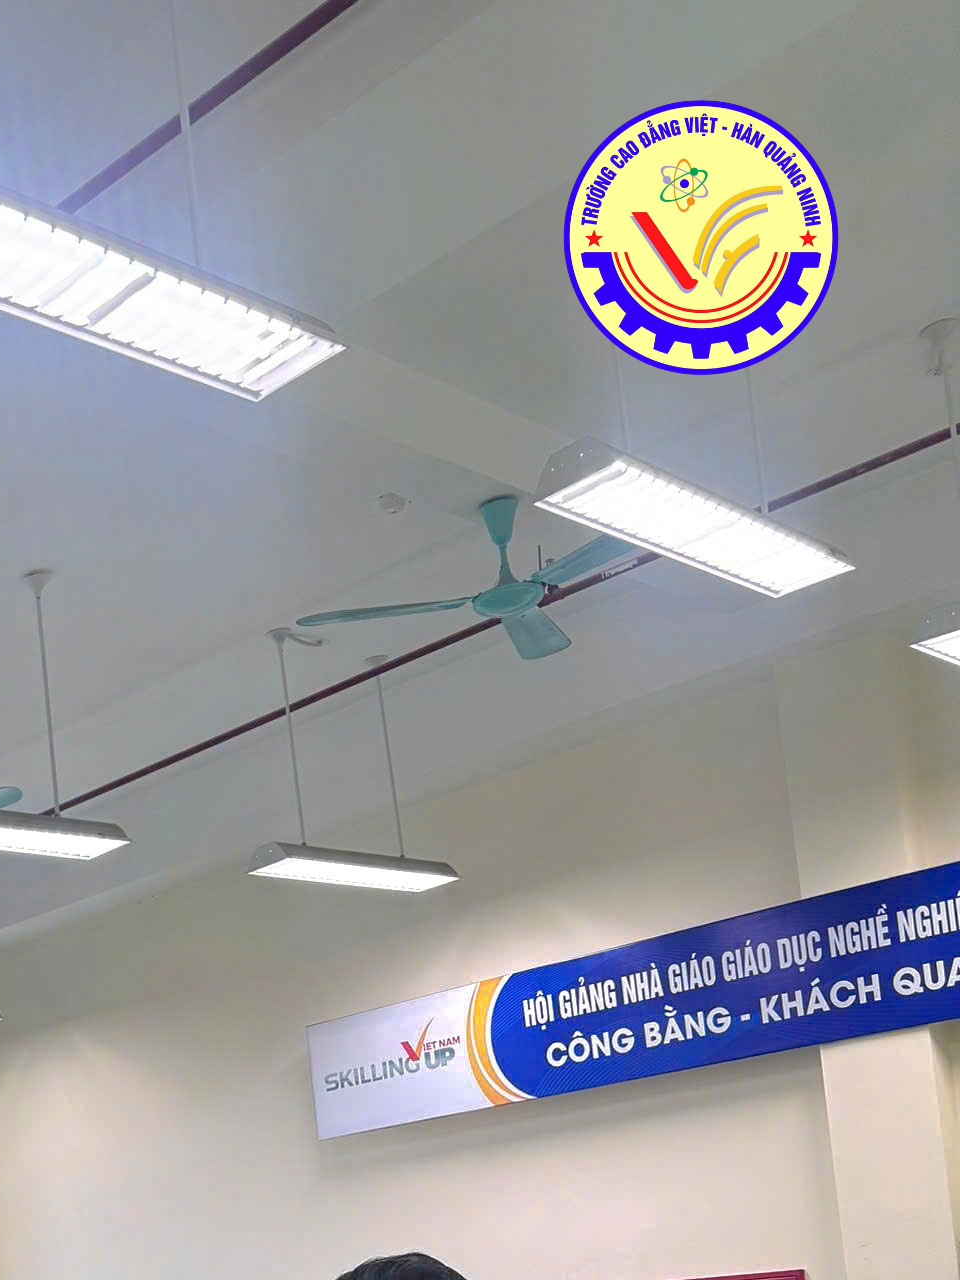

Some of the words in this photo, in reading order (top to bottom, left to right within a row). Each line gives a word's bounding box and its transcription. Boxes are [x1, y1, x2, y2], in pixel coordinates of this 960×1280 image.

[523, 991, 555, 1030] HỘI
[558, 976, 617, 1019] GIẢNG
[621, 963, 664, 1004] NHÀ
[667, 953, 716, 994] GIÁO
[721, 940, 771, 982] GIÁO
[776, 931, 822, 972] DỤC
[827, 904, 891, 958] NGHỀ
[438, 1036, 460, 1049] NAM
[546, 1030, 635, 1067] CÔNG
[643, 1005, 731, 1048] BẰNG
[759, 977, 882, 1024] KHÁCH
[324, 1057, 420, 1092] SKILLING
[424, 1047, 455, 1069] UP
